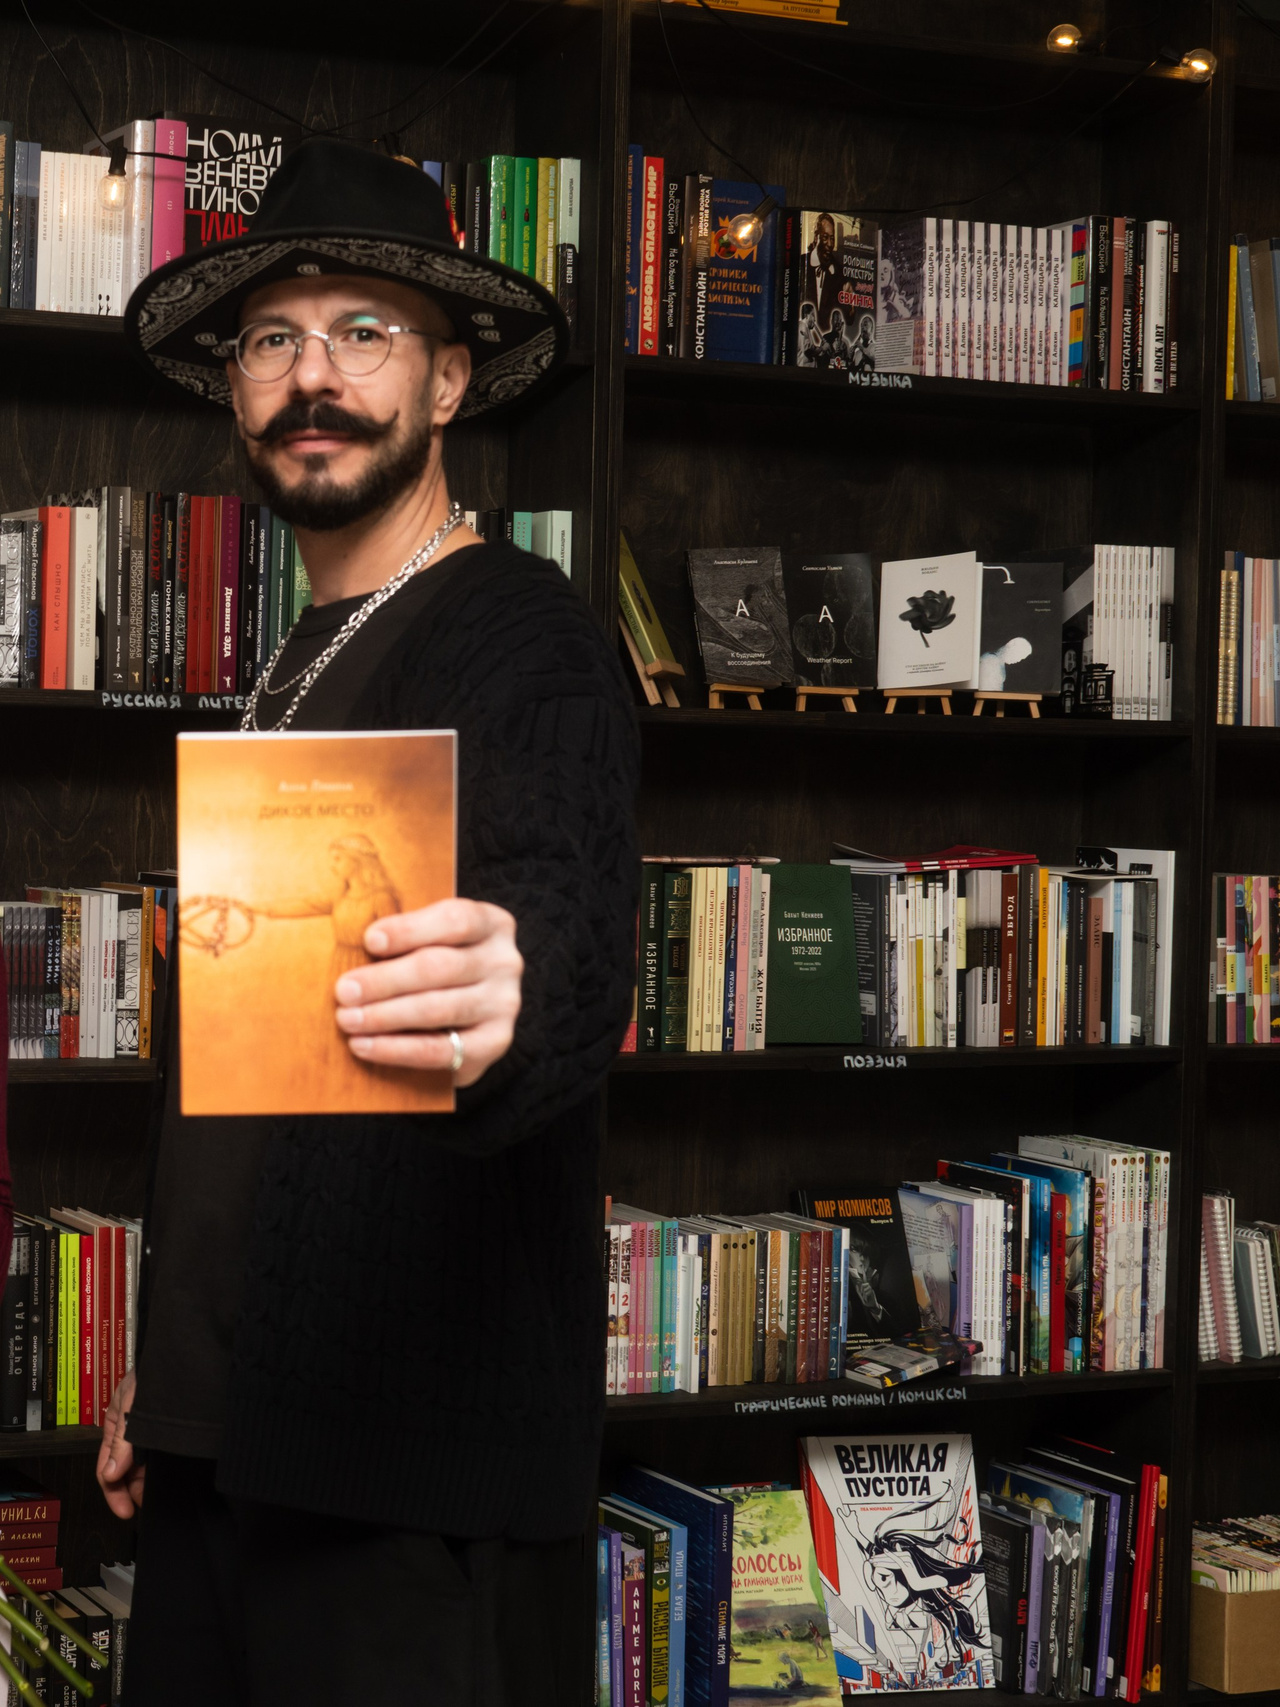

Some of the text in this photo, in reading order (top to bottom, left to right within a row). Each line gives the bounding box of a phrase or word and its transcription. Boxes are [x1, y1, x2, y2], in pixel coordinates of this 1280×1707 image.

[185, 161, 278, 190] ВЕНЕВ
[185, 183, 264, 215] ТИНО
[643, 166, 657, 332] ЛЮБОВЬ СПАСЕТ МИР
[1154, 324, 1164, 372] ROCK ART
[1170, 341, 1178, 372] BEATLES
[848, 371, 913, 389] МУЗЫКА
[832, 657, 852, 665] Report
[102, 692, 181, 709] РУССКАЯ
[1006, 895, 1015, 937] ВБРОД
[777, 928, 833, 943] ИЗБРАННОЕ
[792, 946, 822, 955] 1972-2022
[645, 942, 656, 1010] ИЗБРАННОЕ
[814, 1198, 892, 1218] МИР КОМИКСОВ
[15, 1301, 25, 1375] ОЧЕРЕДЬ
[832, 1393, 885, 1407] РОМАНЫ
[898, 1387, 967, 1404] КОМИКСЫ
[834, 1443, 949, 1474] ВЕЛИКАЯ
[845, 1476, 931, 1497] ПУСТОТА
[674, 1550, 684, 1622] БЕЛАЯ ПТИЦА
[782, 1574, 804, 1585] НОГАХ
[653, 1601, 669, 1688] РАССВЕТ БЛИЗОК
[717, 1601, 728, 1665] СТЕНАНИЕ МОРЯ
[632, 1655, 641, 1707] WORL
